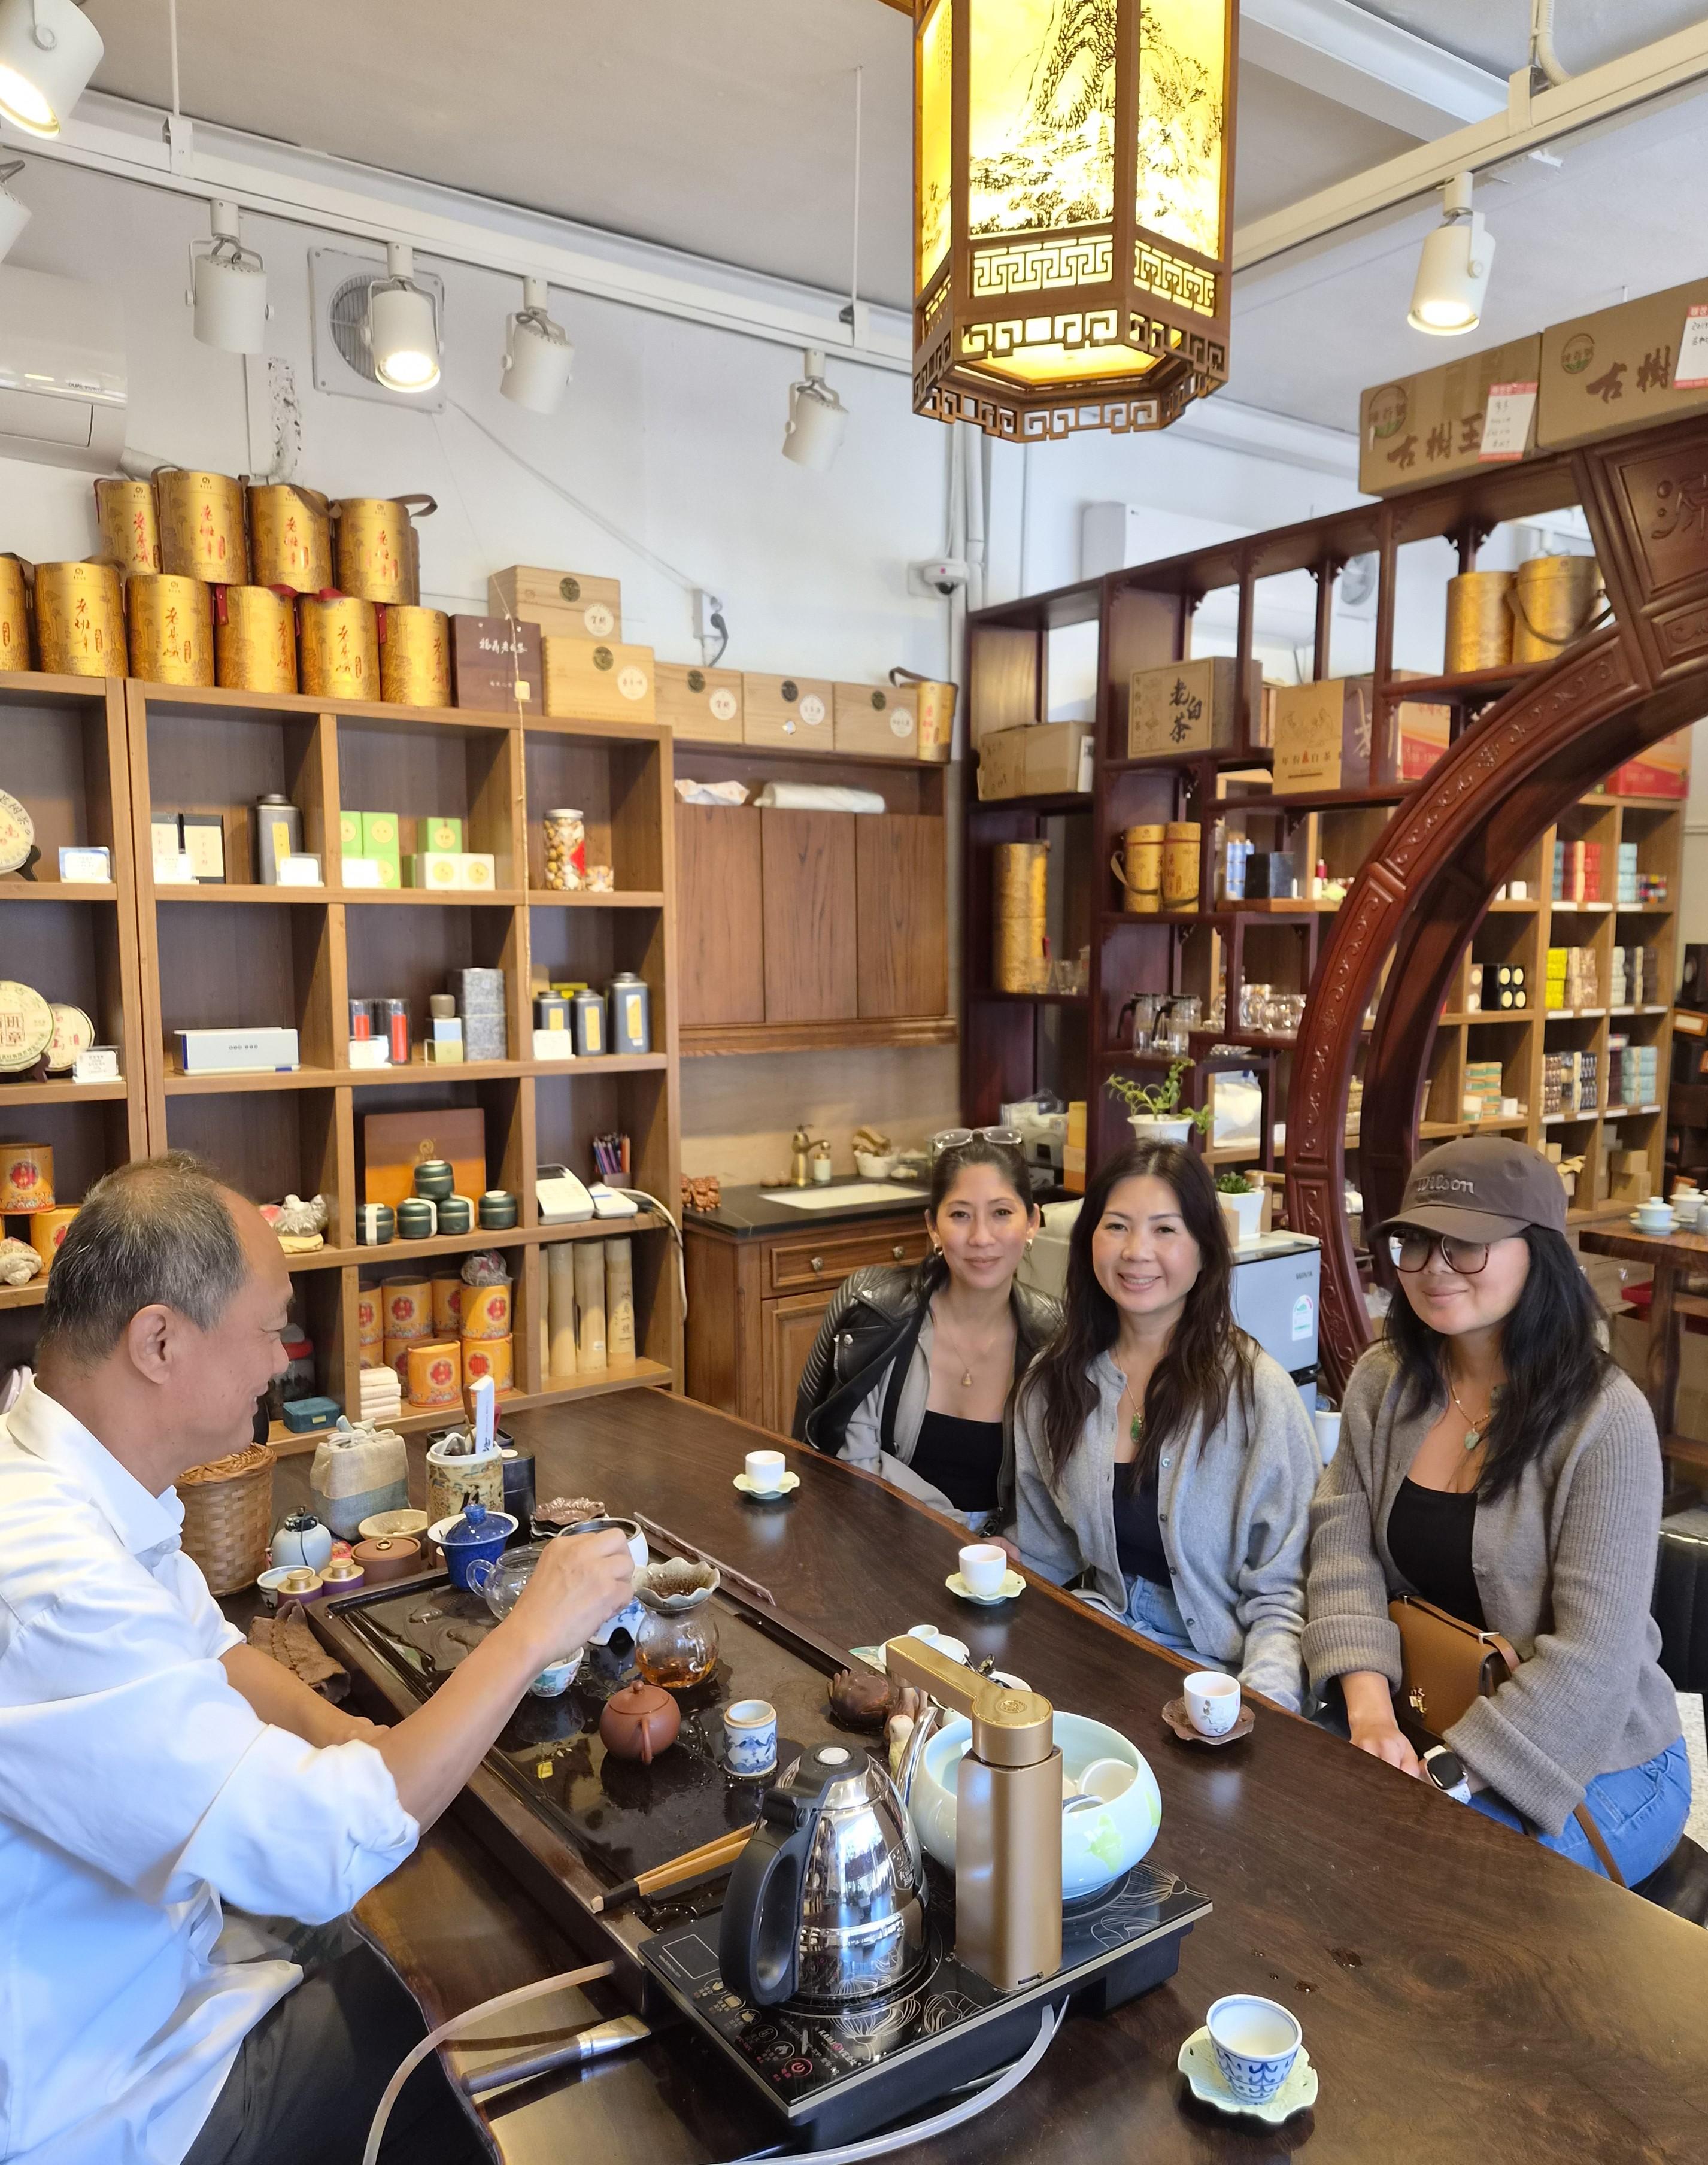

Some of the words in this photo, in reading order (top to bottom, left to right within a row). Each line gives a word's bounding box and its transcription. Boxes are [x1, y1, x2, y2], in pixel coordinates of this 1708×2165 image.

[1169, 677, 1202, 744] 老白茶
[1416, 1174, 1475, 1194] Wilson
